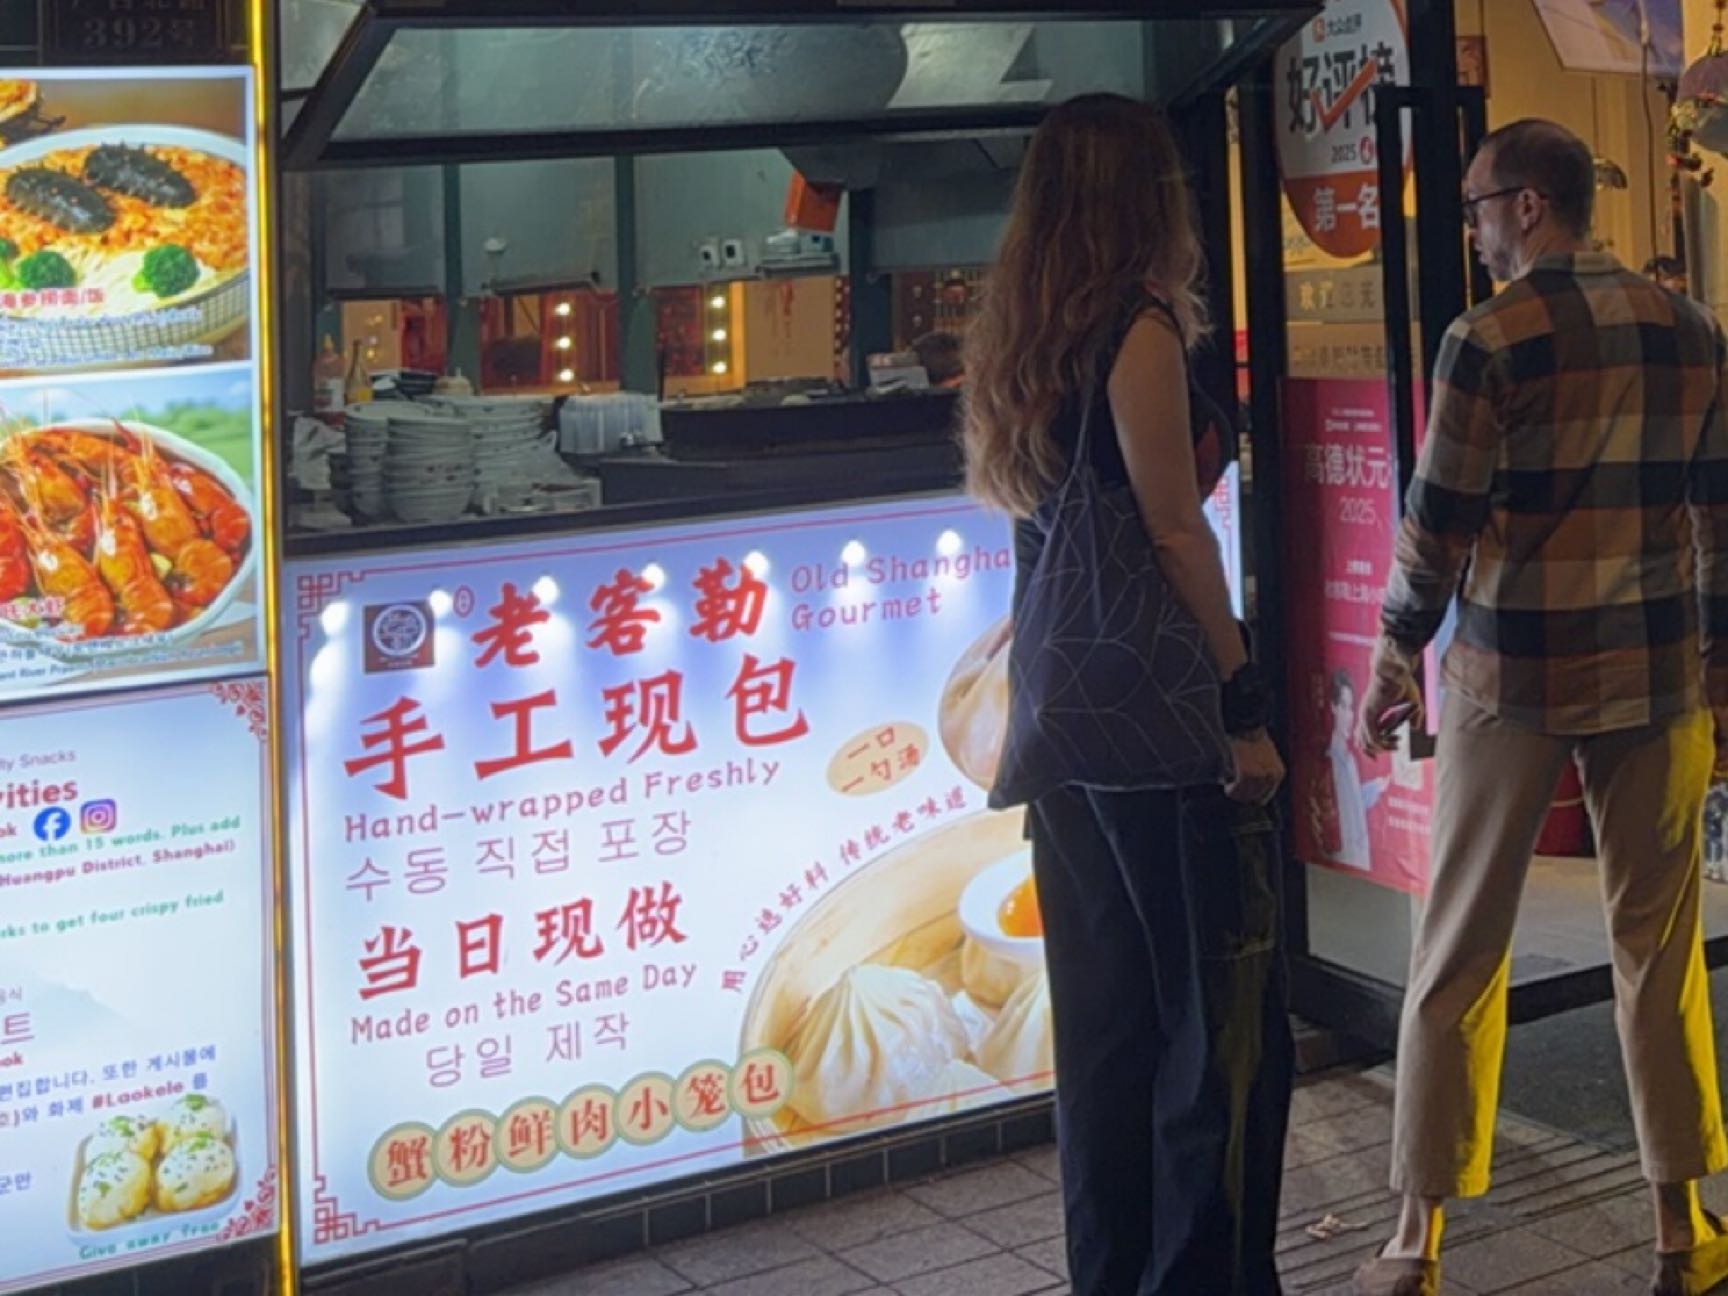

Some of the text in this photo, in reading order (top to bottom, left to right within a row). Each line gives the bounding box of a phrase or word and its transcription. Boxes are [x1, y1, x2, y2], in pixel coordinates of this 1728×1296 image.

[1303, 442, 1394, 490] 高德状元
[790, 544, 1012, 593] Old Shangha
[790, 586, 943, 633] Gourmet
[471, 555, 769, 668] 老客勒
[343, 653, 812, 800] 手工现包
[209, 814, 240, 831] add
[344, 757, 781, 842] Hand-wrapped Freshly
[345, 807, 692, 902] 수동 직접 포장
[357, 879, 689, 1002] 当日现做
[350, 961, 697, 1046] Made on the Same Day
[426, 1010, 631, 1090] 당일 제작
[384, 1059, 781, 1189] 蟹粉鲜肉小笼包
